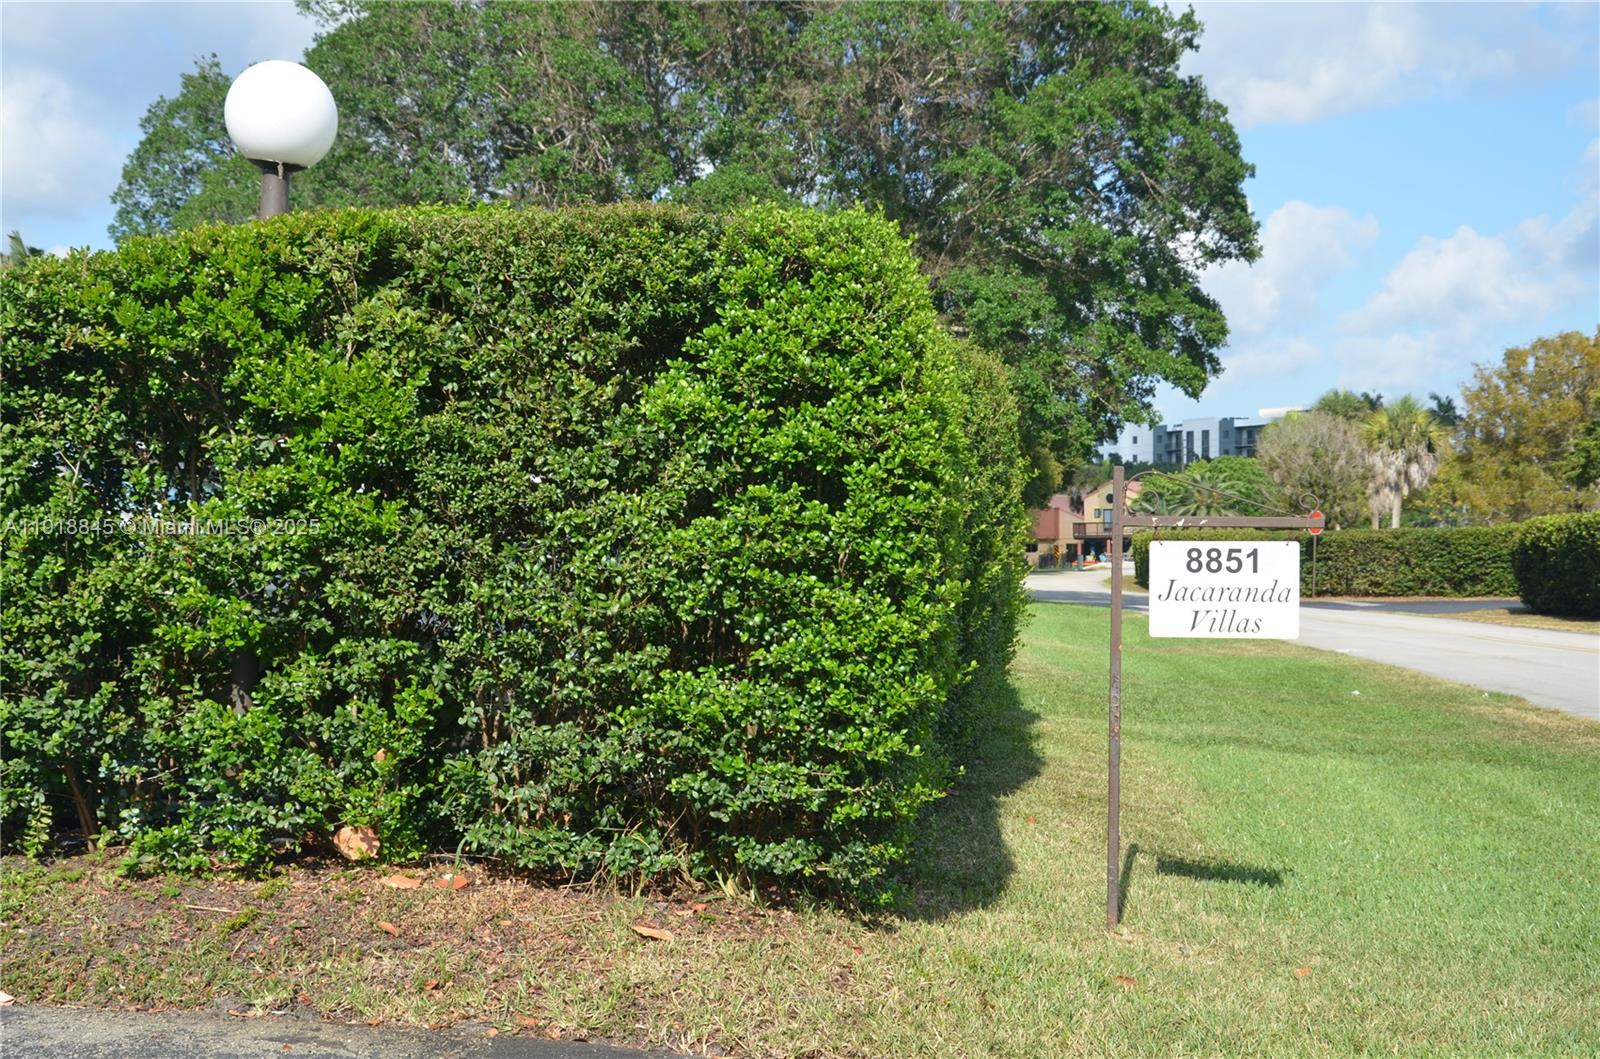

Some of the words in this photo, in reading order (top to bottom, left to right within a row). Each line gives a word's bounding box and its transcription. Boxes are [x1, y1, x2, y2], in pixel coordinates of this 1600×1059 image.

[1186, 548, 1259, 574] 8851
[1158, 579, 1292, 603] Jacaranda
[1190, 609, 1263, 634] Villas
